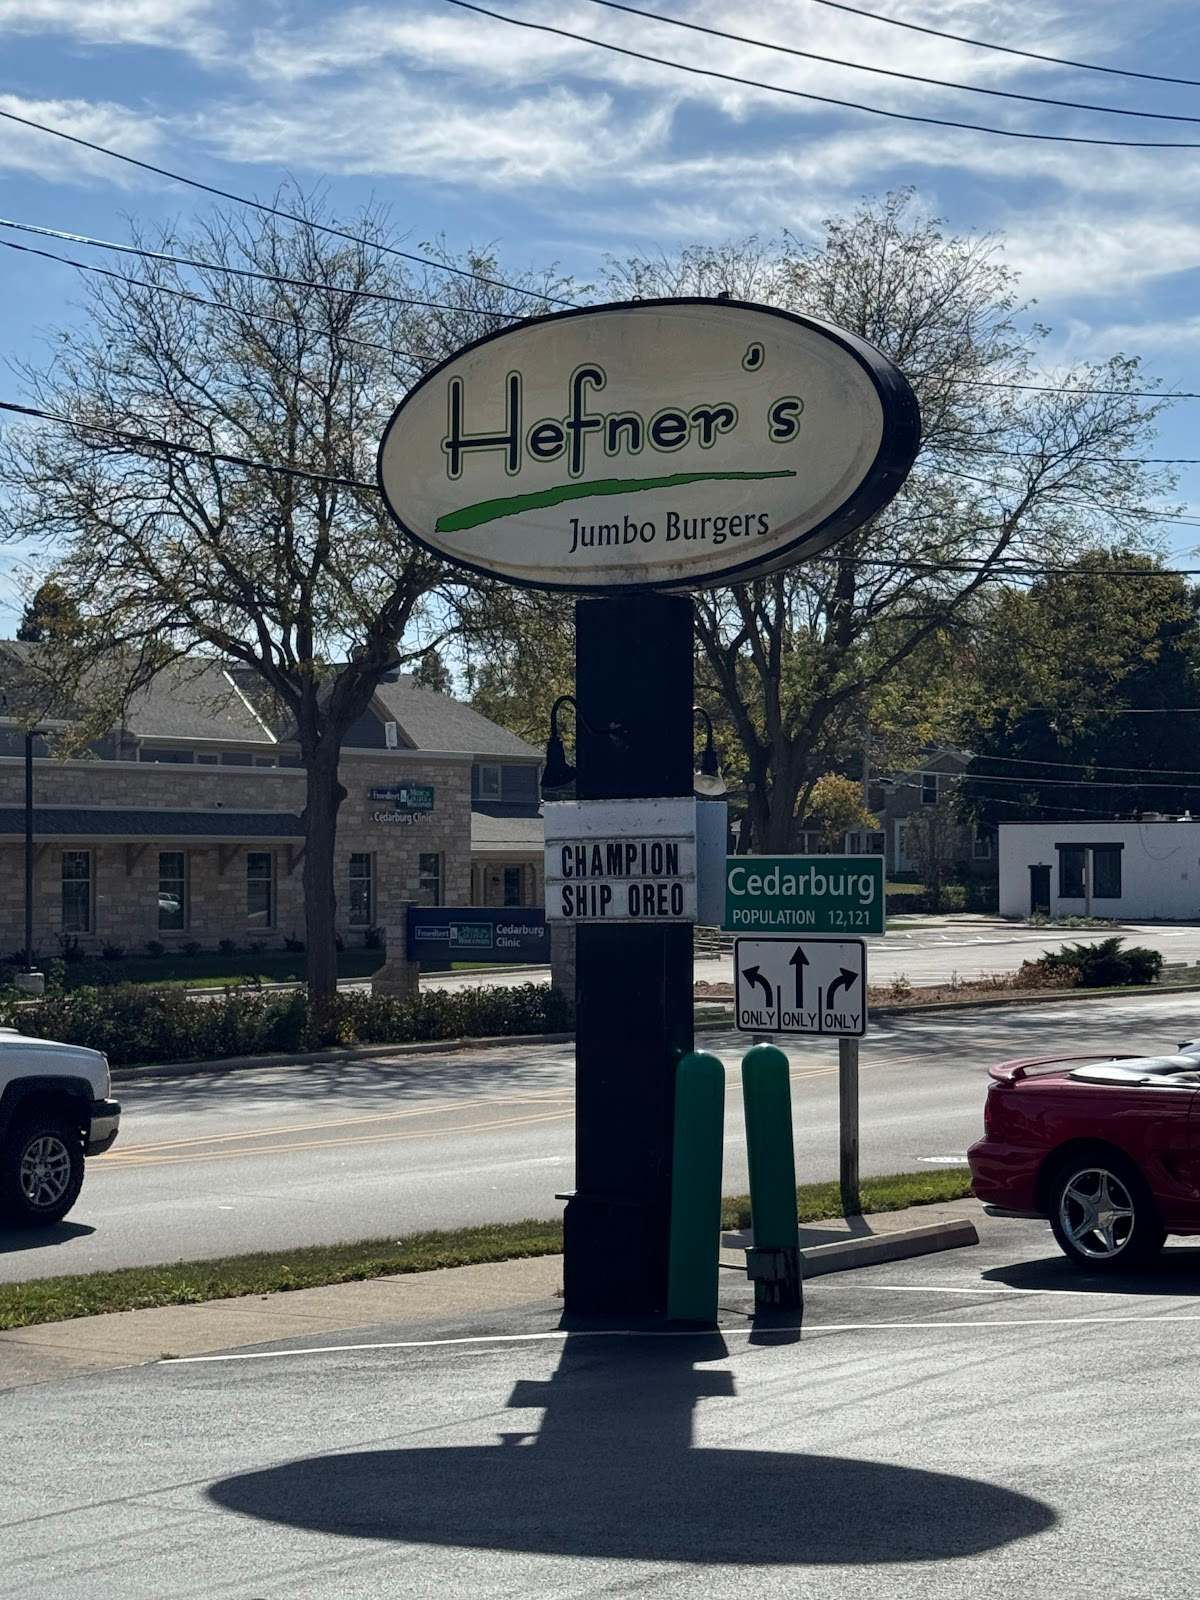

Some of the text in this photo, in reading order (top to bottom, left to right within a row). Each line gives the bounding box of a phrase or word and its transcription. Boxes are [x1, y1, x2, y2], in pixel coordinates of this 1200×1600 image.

[441, 342, 804, 480] Hefner's
[567, 511, 770, 553] Jumbo Burgers
[374, 810, 433, 825] Cedarburg Clinic
[561, 842, 679, 878] CHAMPION
[727, 865, 875, 905] Cedarburg
[561, 882, 684, 917] SHIP OREO
[496, 924, 545, 937] Cedarburg
[732, 909, 870, 927] POPULATION 12,121
[496, 937, 521, 948] Clinic
[741, 1010, 860, 1029] ONLY ONLY ONLY
